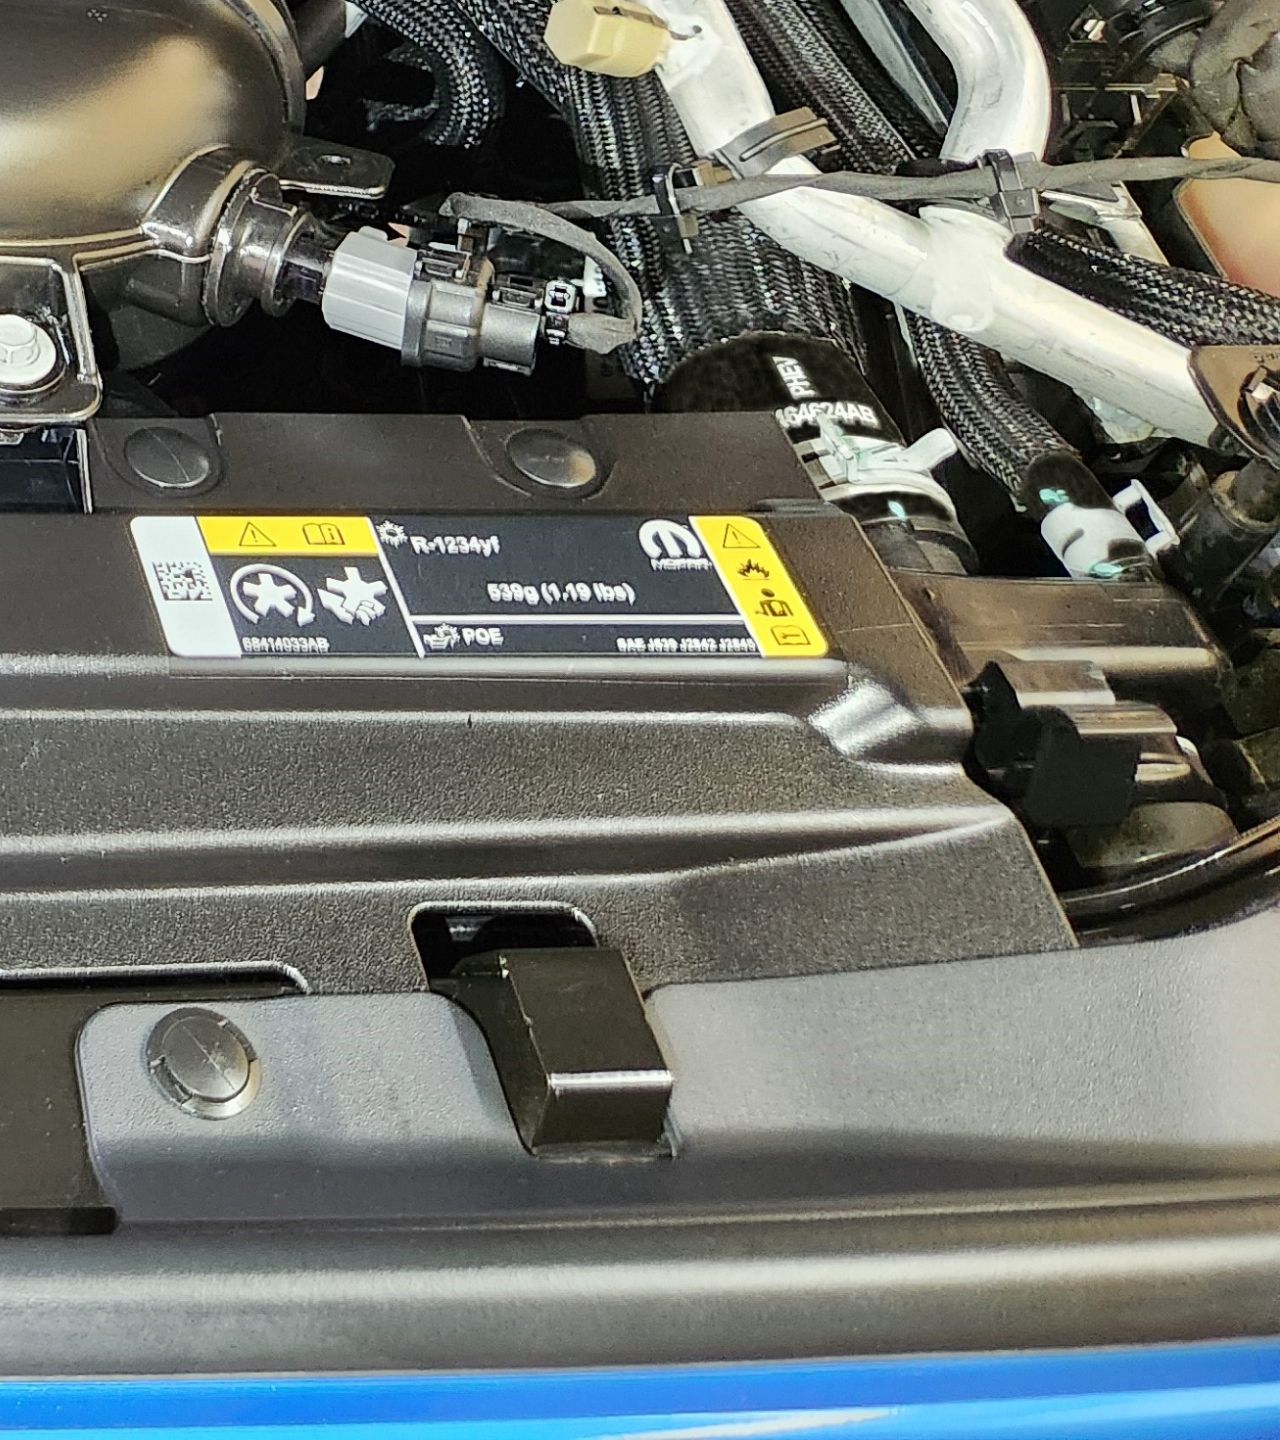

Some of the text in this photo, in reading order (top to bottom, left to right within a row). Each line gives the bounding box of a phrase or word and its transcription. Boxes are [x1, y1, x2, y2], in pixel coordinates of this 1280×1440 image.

[771, 355, 819, 401] PHEV
[410, 534, 501, 558] R-1234yf
[486, 582, 637, 606] 539g (1.19 lbs)
[462, 627, 504, 647] POE
